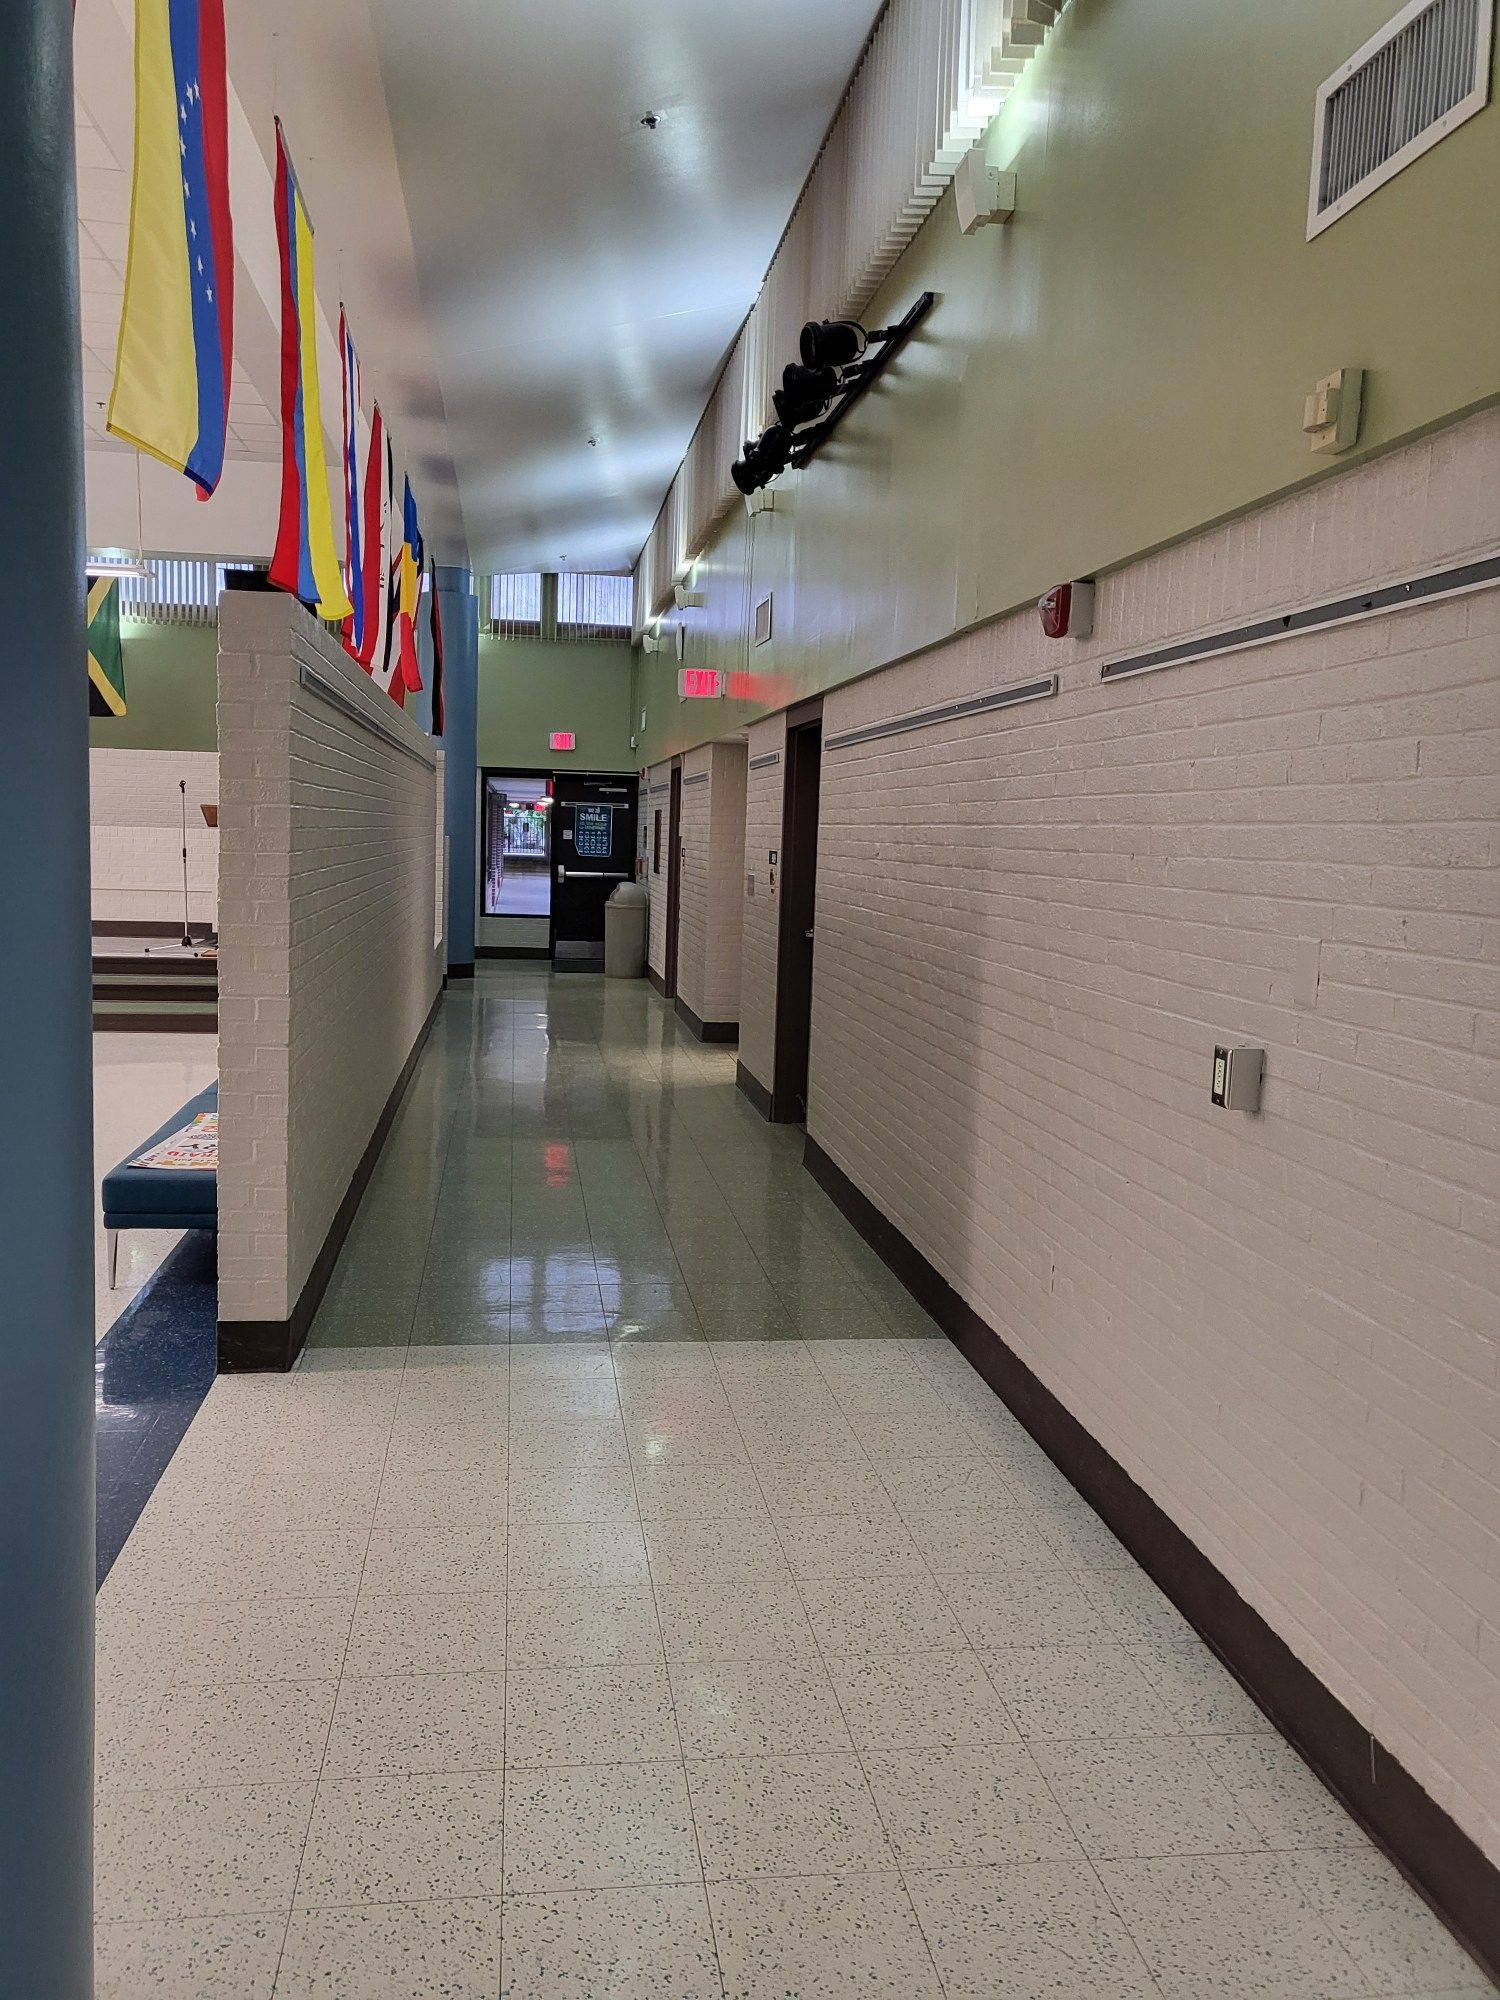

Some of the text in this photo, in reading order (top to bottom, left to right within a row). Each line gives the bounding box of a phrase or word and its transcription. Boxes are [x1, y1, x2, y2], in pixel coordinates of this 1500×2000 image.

[686, 670, 717, 696] EXIT
[554, 733, 572, 748] EXIT
[579, 813, 608, 821] SMILE
